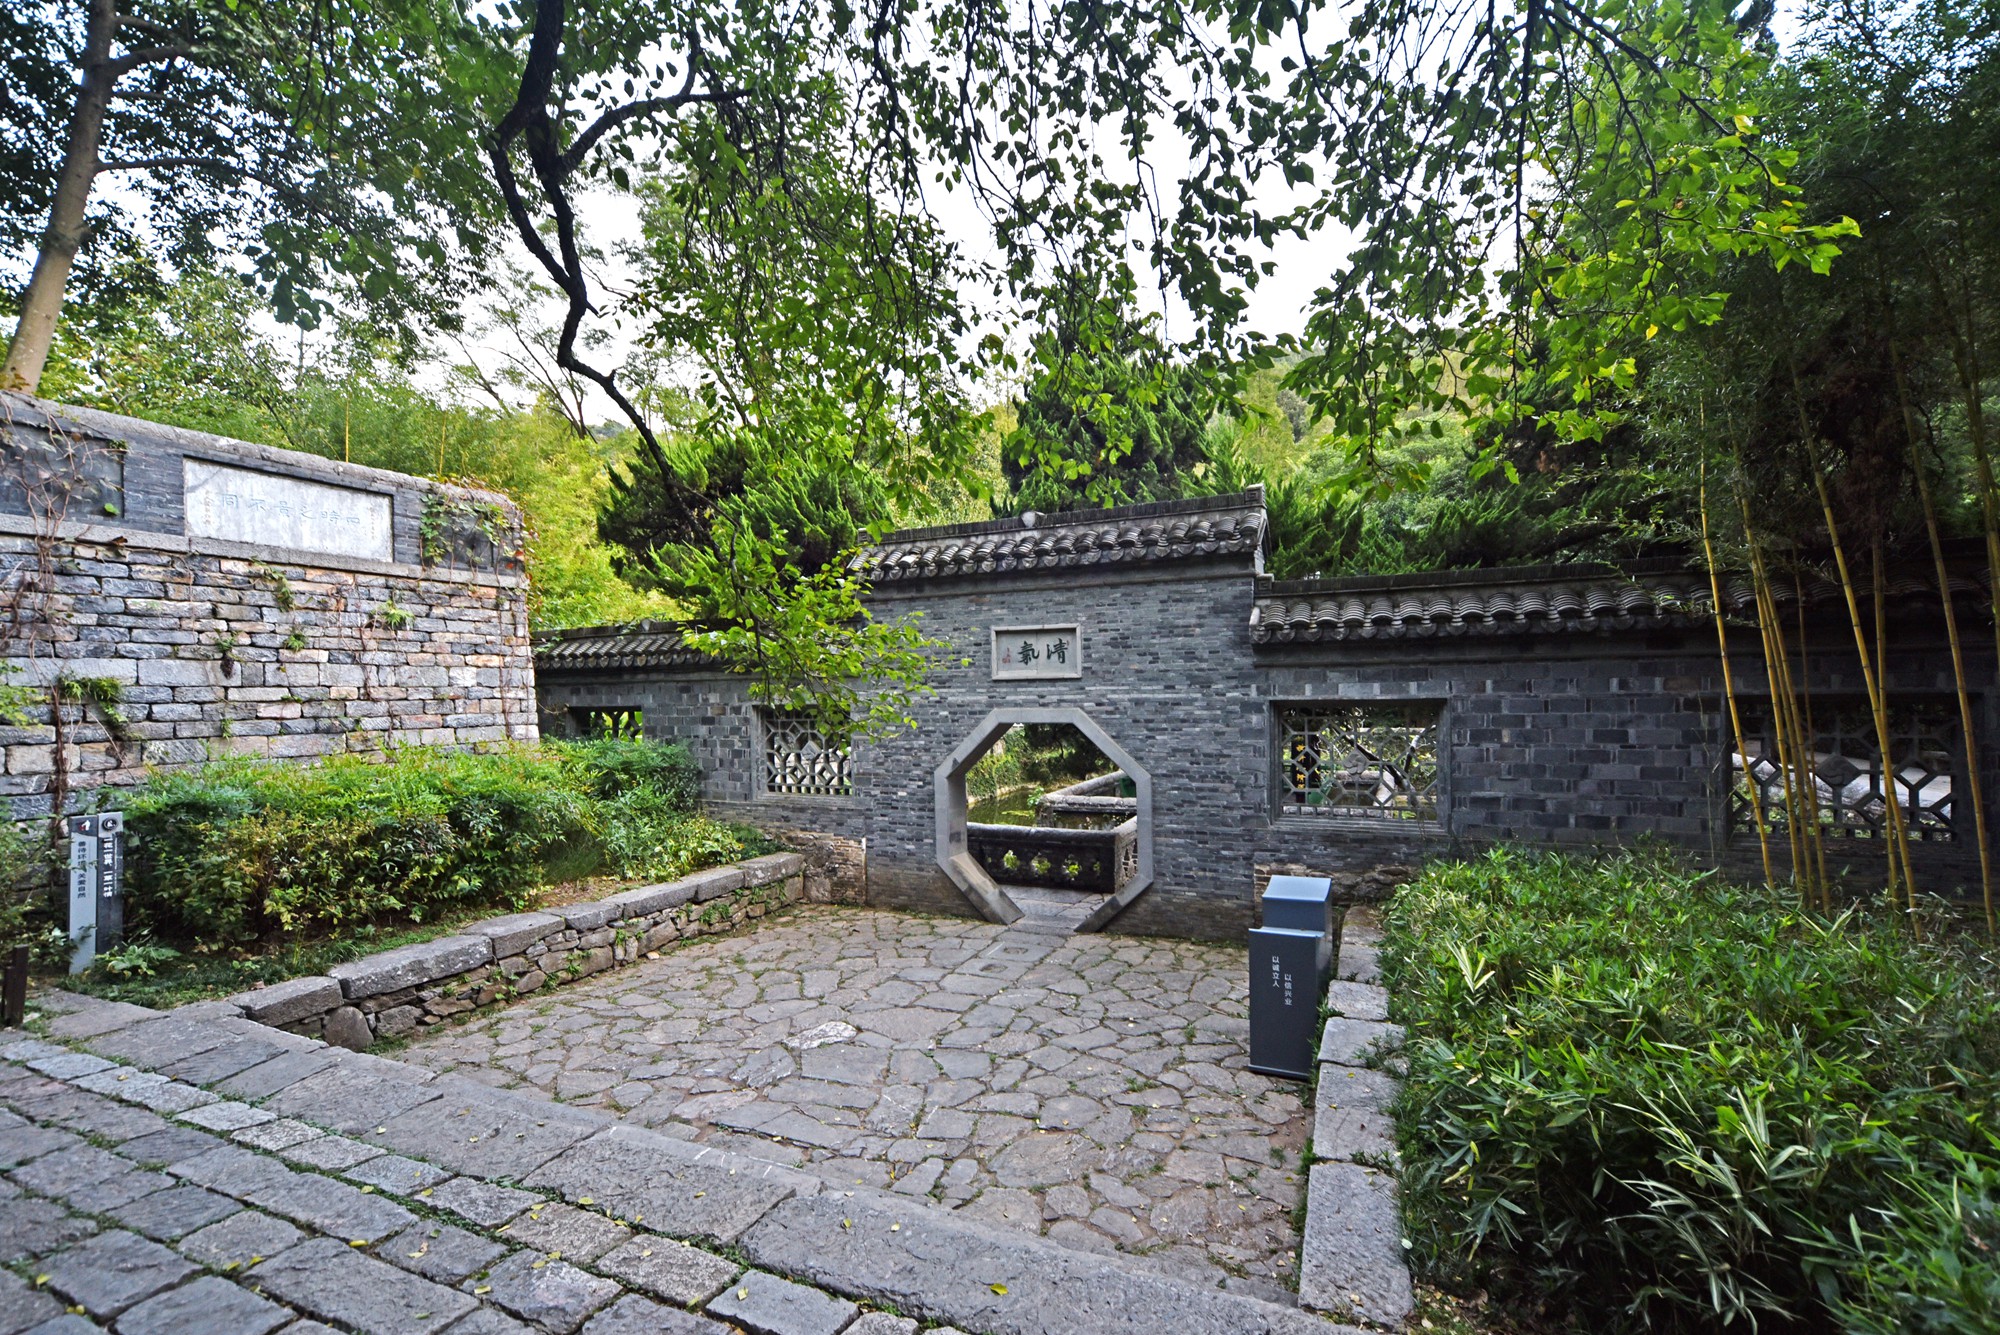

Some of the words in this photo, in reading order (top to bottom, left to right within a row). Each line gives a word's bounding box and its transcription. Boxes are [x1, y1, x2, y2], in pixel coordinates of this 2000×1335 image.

[1272, 955, 1280, 988] 以诚立人
[1284, 973, 1292, 1006] 以信兴业
